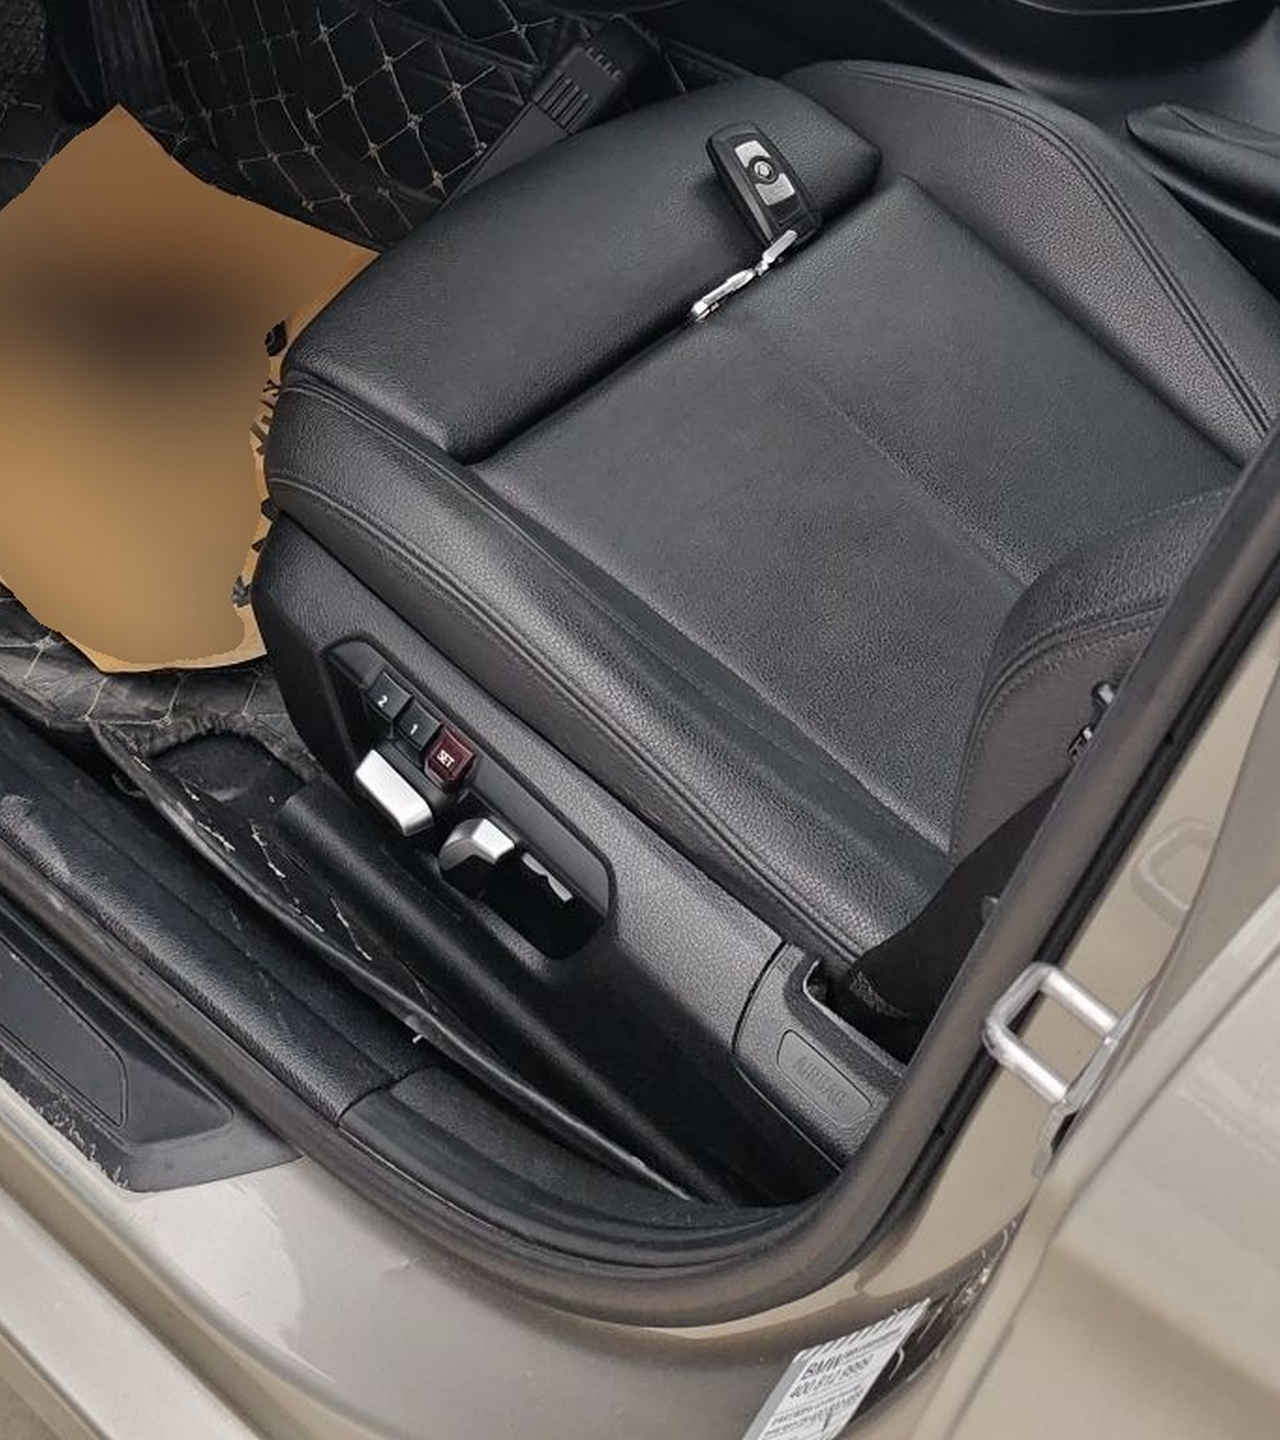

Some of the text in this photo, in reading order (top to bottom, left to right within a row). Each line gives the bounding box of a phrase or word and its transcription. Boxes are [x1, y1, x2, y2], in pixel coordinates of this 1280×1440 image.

[377, 695, 388, 708] 2
[410, 724, 418, 735] 1
[437, 749, 455, 768] SET
